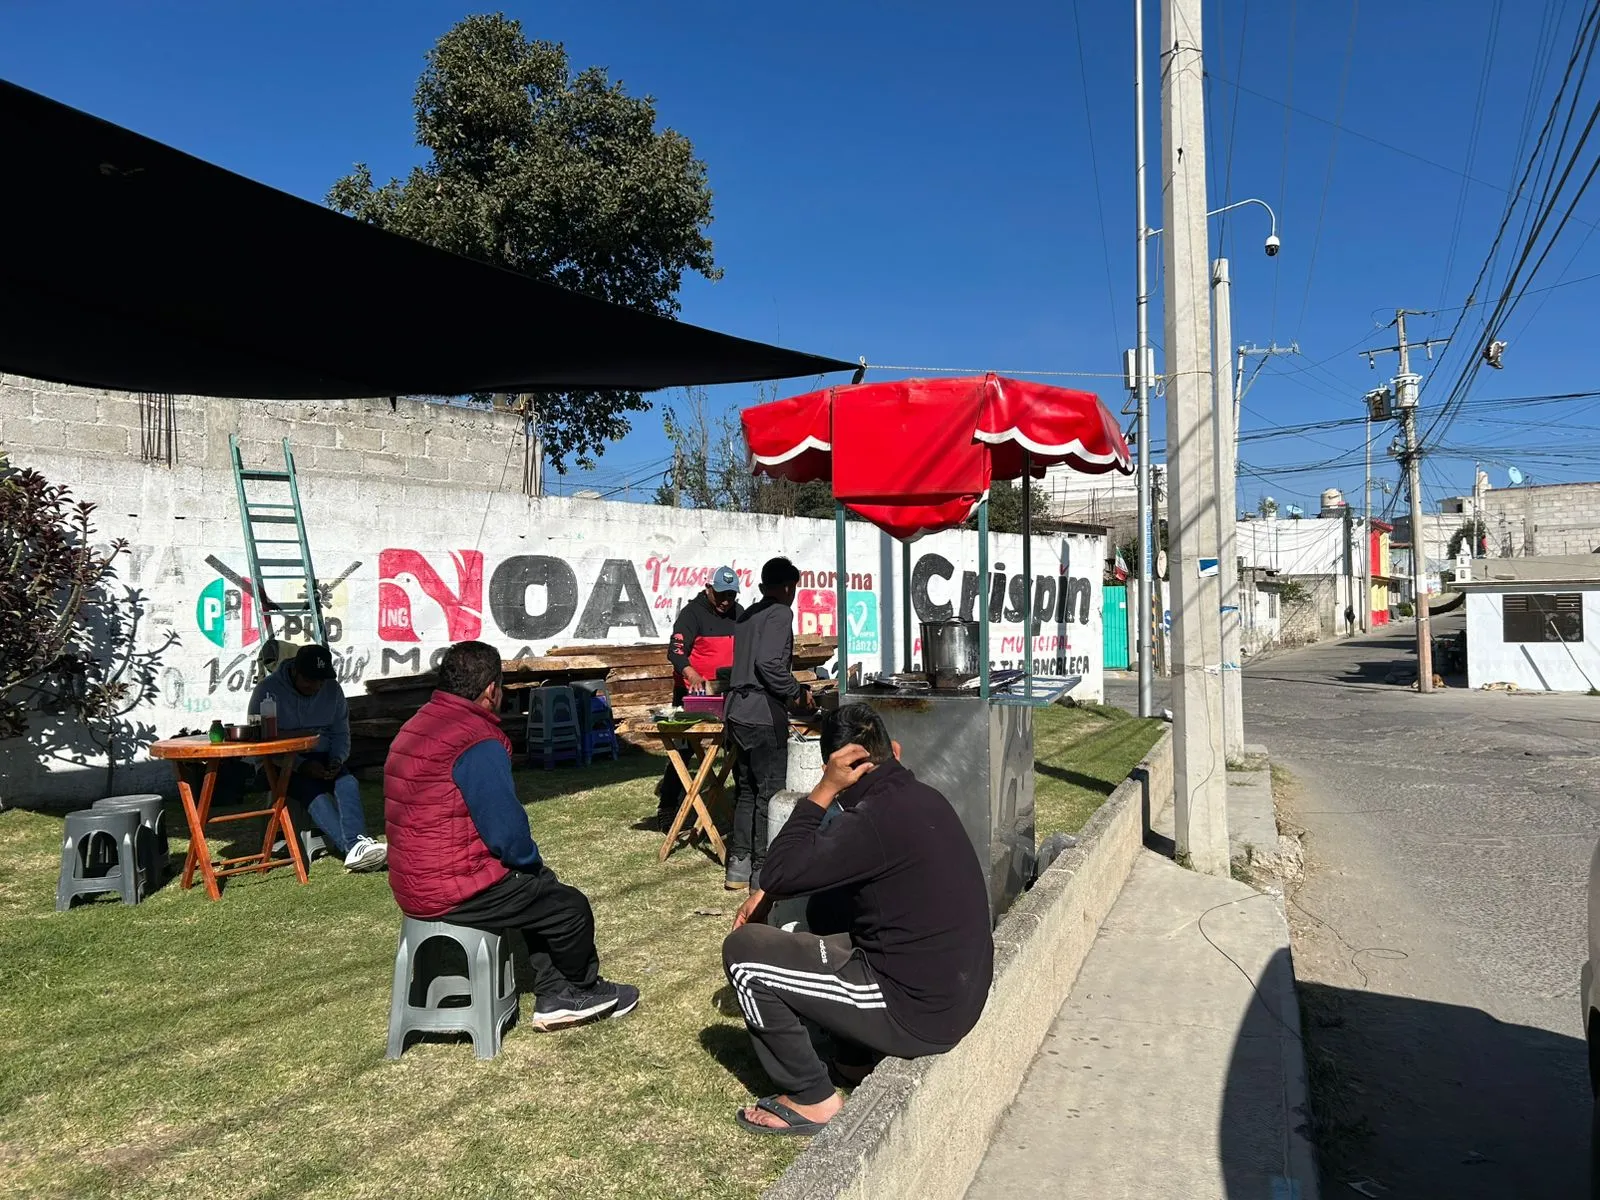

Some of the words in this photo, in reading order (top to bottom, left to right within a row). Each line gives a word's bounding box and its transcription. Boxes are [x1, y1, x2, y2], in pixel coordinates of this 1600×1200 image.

[797, 569, 872, 590] morna
[1001, 635, 1072, 653] MUICIPAL
[819, 939, 828, 964] adidas
